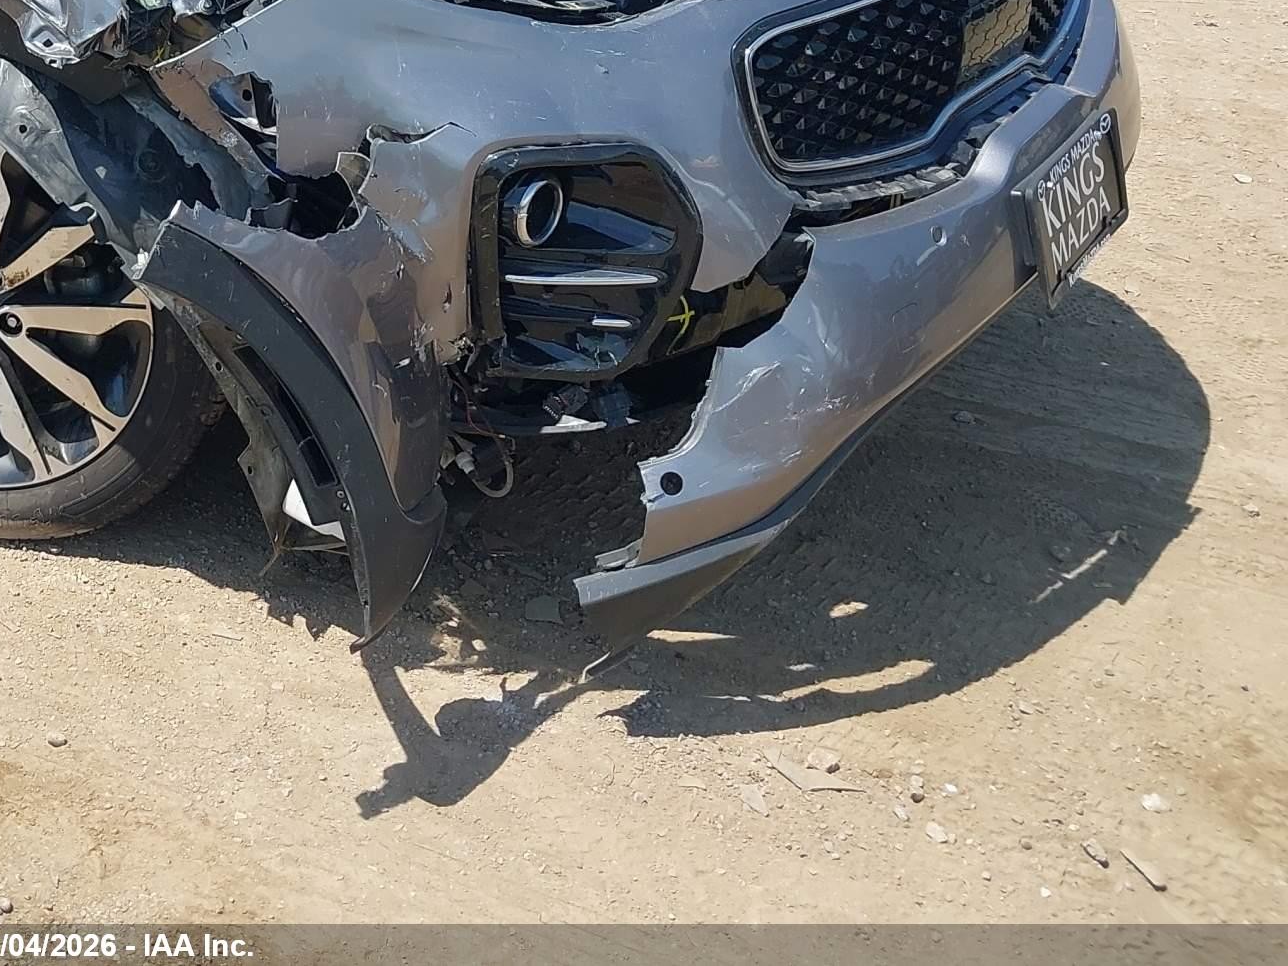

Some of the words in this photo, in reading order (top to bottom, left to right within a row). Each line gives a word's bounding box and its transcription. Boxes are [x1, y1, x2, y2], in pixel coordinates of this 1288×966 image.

[1042, 141, 1105, 237] KINGS
[1049, 153, 1071, 184] KINGS
[1071, 128, 1096, 160] MAZDA
[1051, 186, 1111, 274] MAZDA
